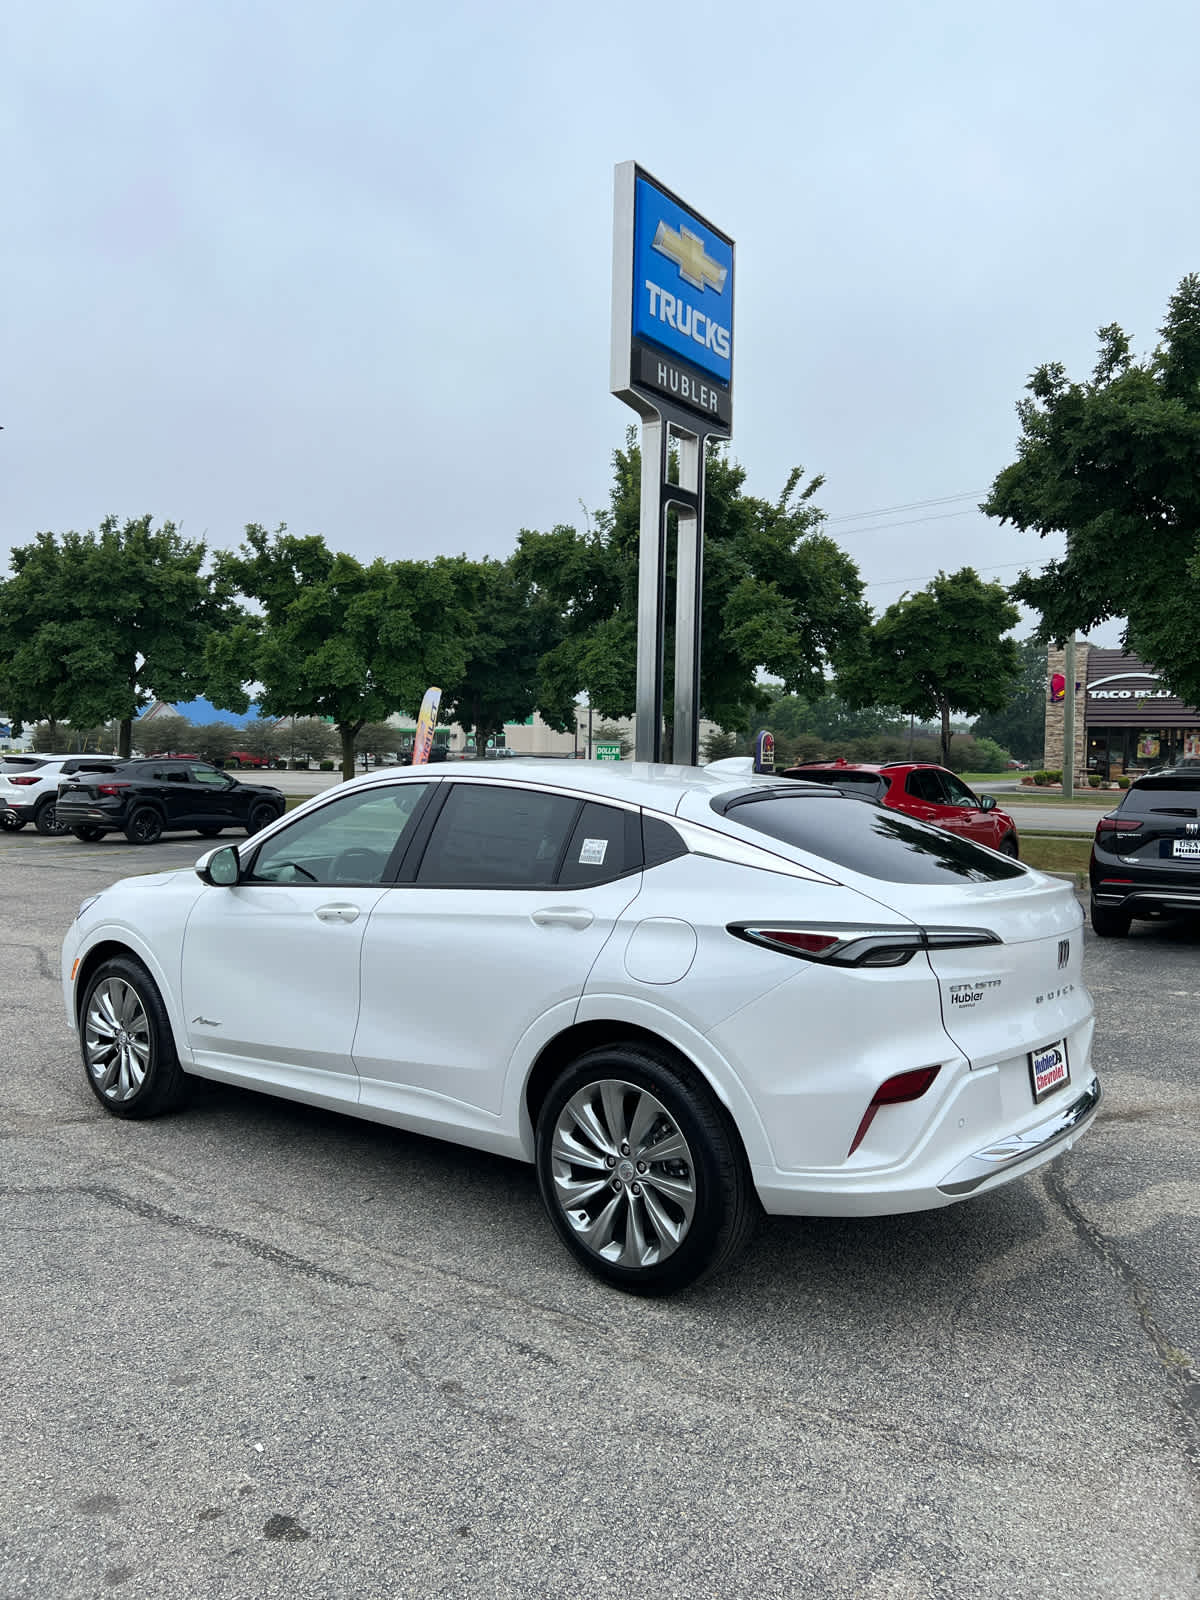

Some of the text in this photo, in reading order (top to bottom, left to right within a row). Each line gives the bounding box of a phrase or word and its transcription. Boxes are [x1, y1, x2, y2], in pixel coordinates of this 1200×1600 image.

[645, 280, 730, 360] TRUCKS
[657, 362, 718, 413] HUBLER
[1089, 690, 1131, 698] TACO
[951, 992, 983, 1004] Hubler
[1034, 1054, 1056, 1076] Hubler
[1036, 1064, 1065, 1091] Chevrolet
